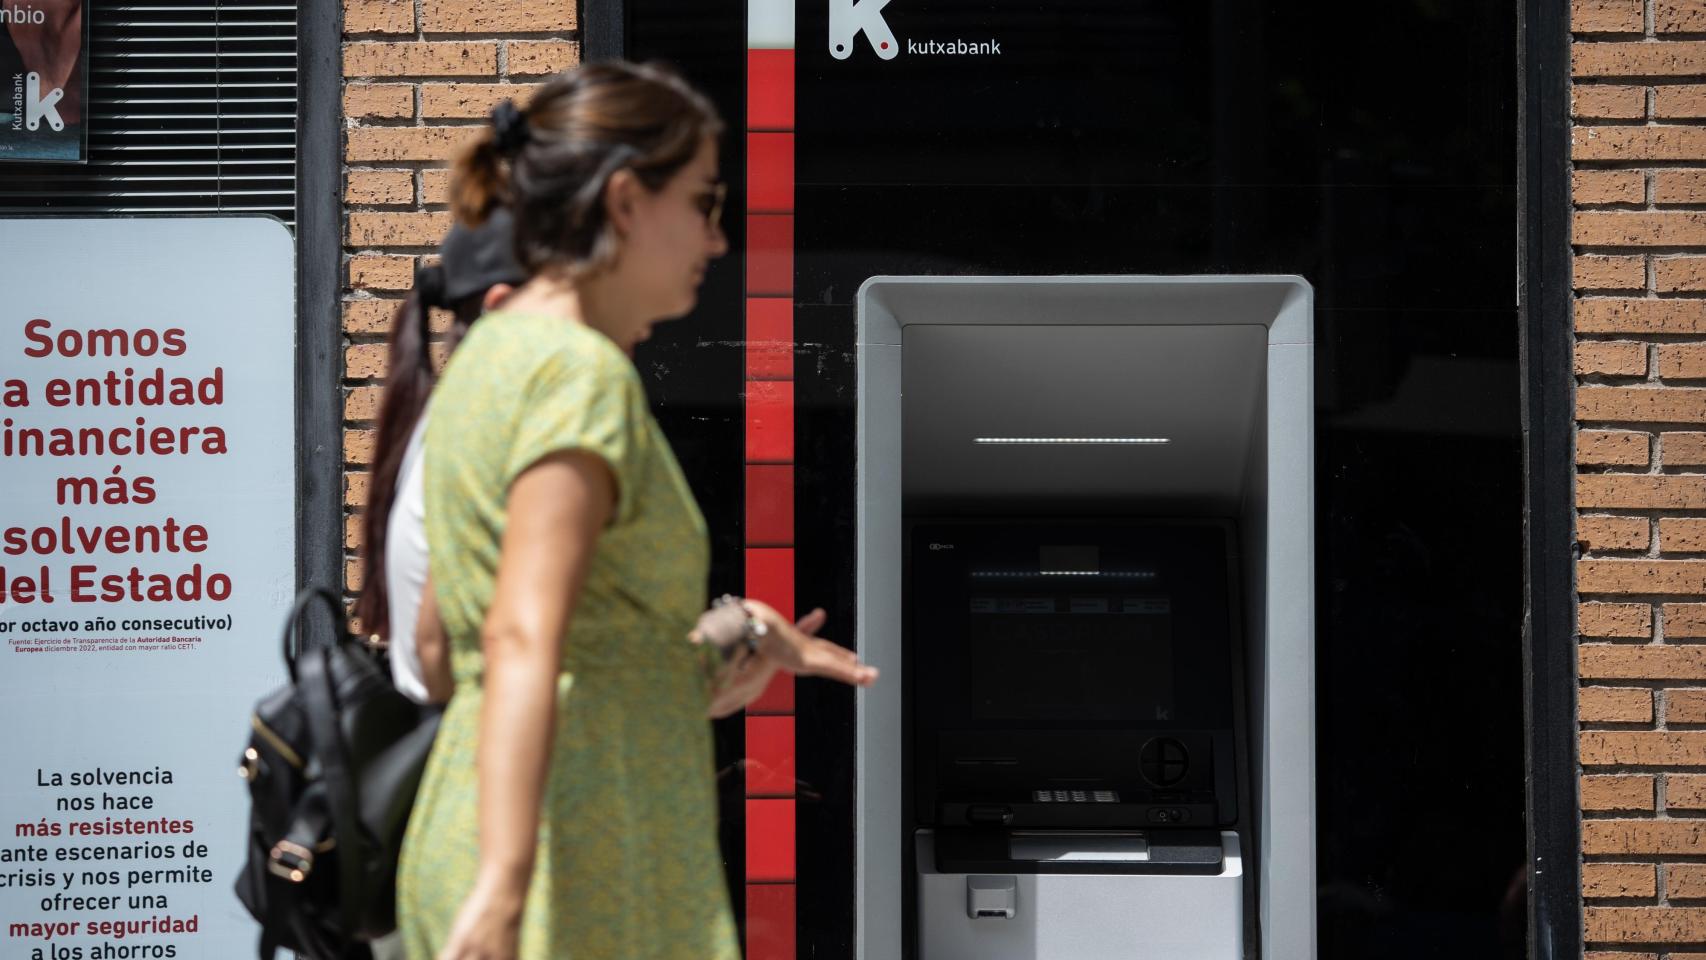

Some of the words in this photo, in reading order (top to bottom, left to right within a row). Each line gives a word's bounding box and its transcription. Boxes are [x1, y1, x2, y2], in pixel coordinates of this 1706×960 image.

[908, 38, 1001, 55] kutxabank
[12, 73, 23, 130] Kutxabank
[24, 318, 187, 358] Somos
[0, 379, 29, 407] a
[45, 367, 224, 407] entidad
[0, 417, 228, 456] inanciera
[57, 465, 156, 505] más
[3, 516, 208, 555] solvente
[70, 563, 232, 603] Estado
[21, 618, 79, 632] octavo
[84, 616, 116, 632] año
[121, 614, 233, 632] consecutivo)
[72, 637, 119, 645] Transparencia
[37, 768, 63, 787] La
[70, 766, 173, 786] solvencia
[57, 796, 95, 811] nos
[103, 792, 153, 811] hace
[15, 818, 61, 837] más
[69, 817, 194, 836] resistentes
[1, 844, 48, 862] ante
[55, 841, 175, 861] escenarios
[182, 840, 208, 859] de
[0, 868, 56, 887] crisis
[63, 871, 74, 890] y
[82, 870, 120, 886] nos
[128, 865, 213, 888] permite
[40, 893, 121, 911] ofrecer
[128, 894, 168, 910] una
[9, 921, 80, 941] mayor
[87, 915, 198, 939] seguridad
[32, 947, 43, 960] a
[51, 943, 83, 960] los
[90, 942, 176, 960] ahorros
